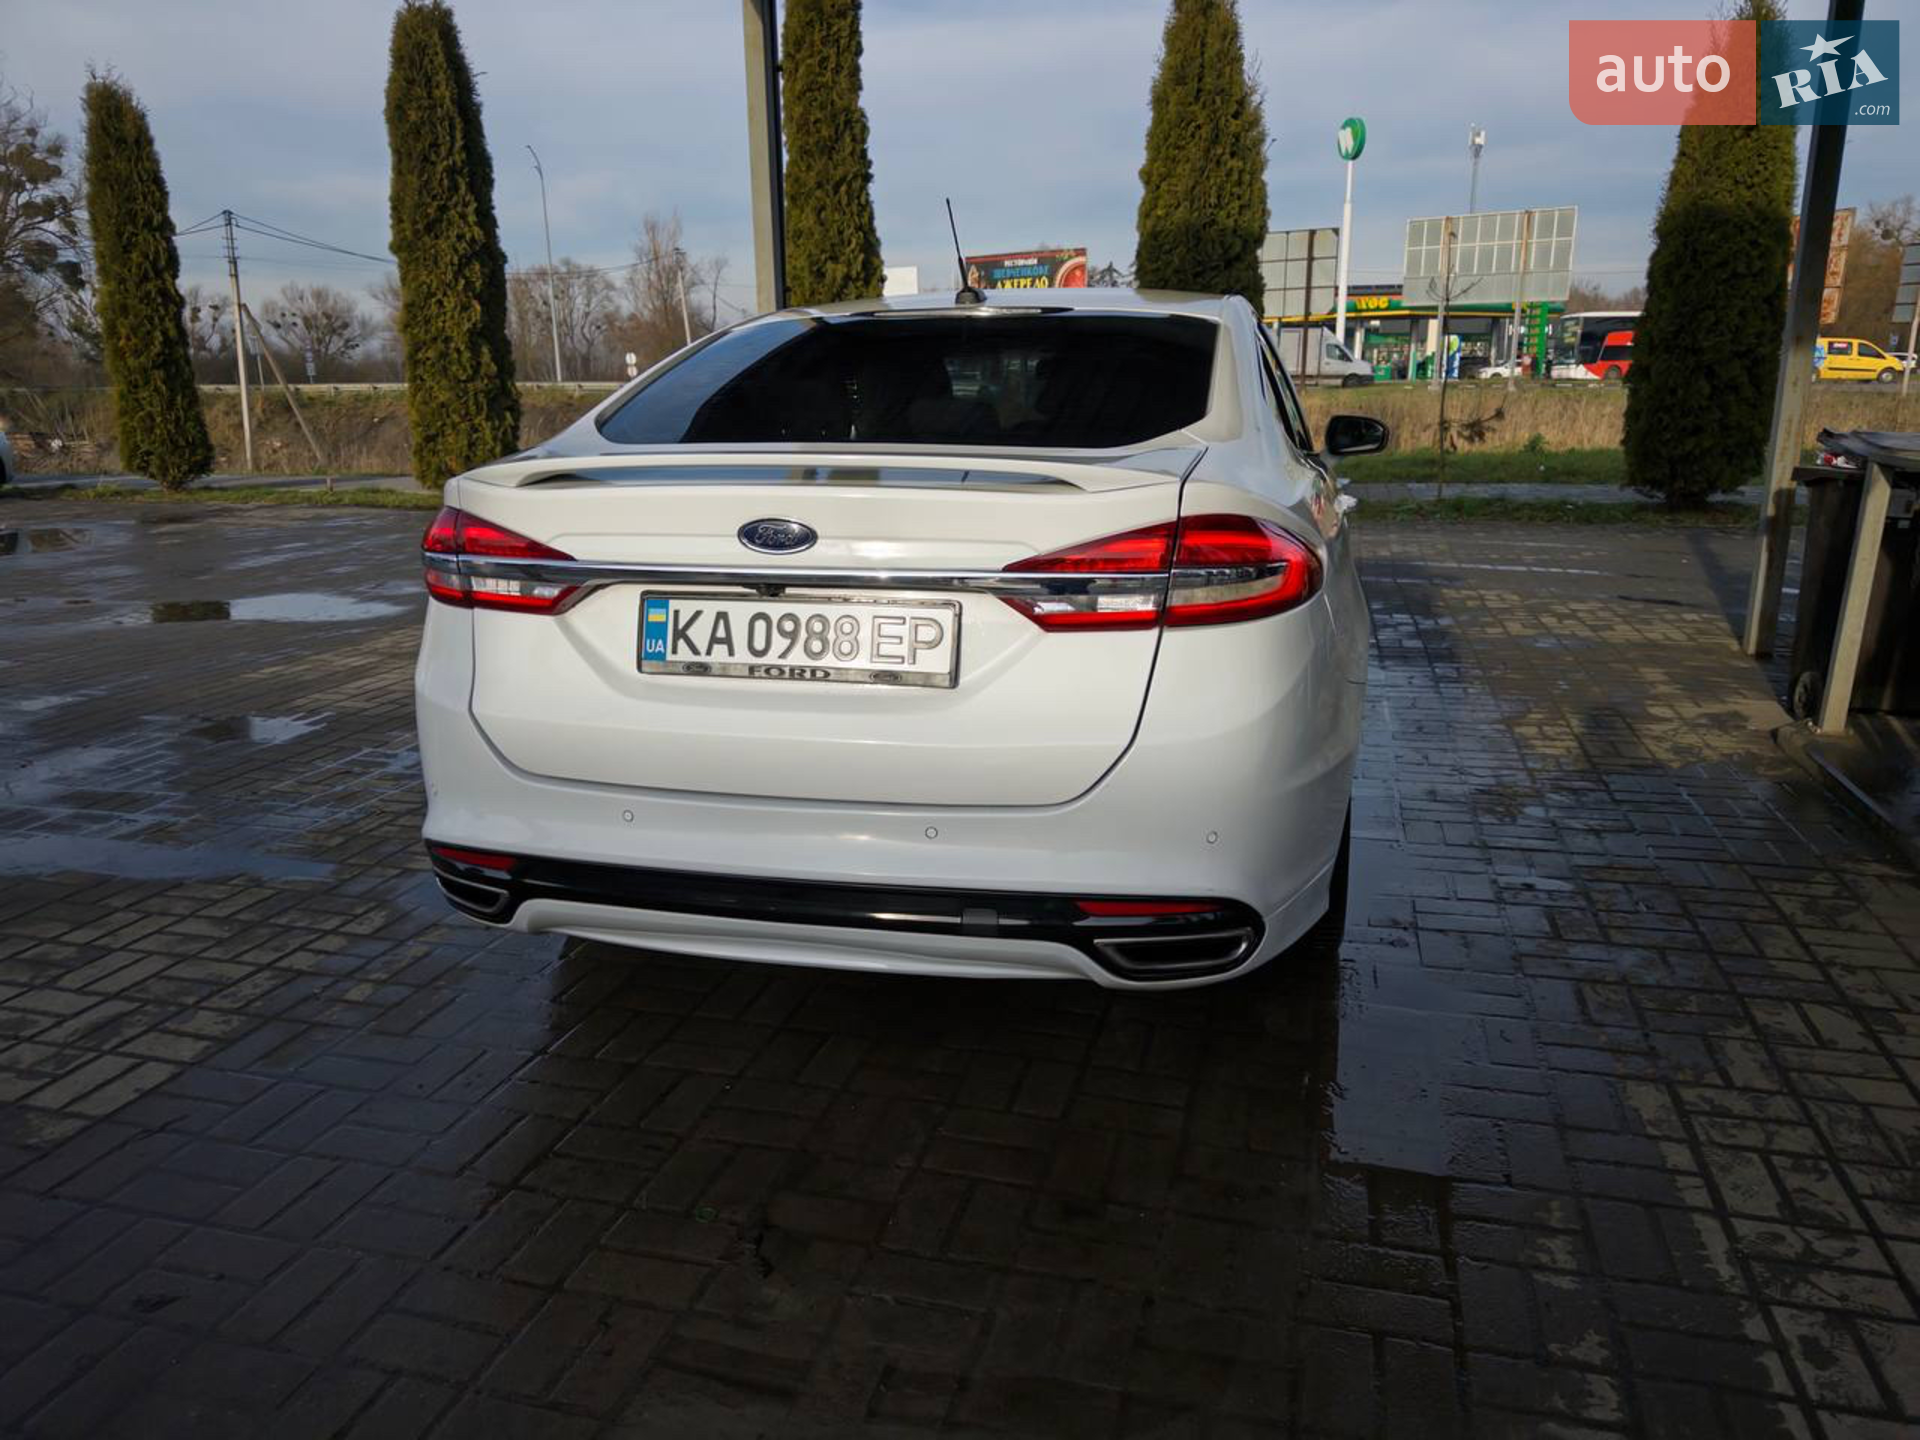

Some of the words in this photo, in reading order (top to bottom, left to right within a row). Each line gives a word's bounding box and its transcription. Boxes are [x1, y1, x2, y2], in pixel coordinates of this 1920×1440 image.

[755, 524, 800, 546] Ford
[646, 638, 665, 653] UA
[671, 609, 736, 657] KA
[747, 611, 860, 662] 0988
[869, 615, 944, 665] EP
[748, 665, 831, 680] FORD
